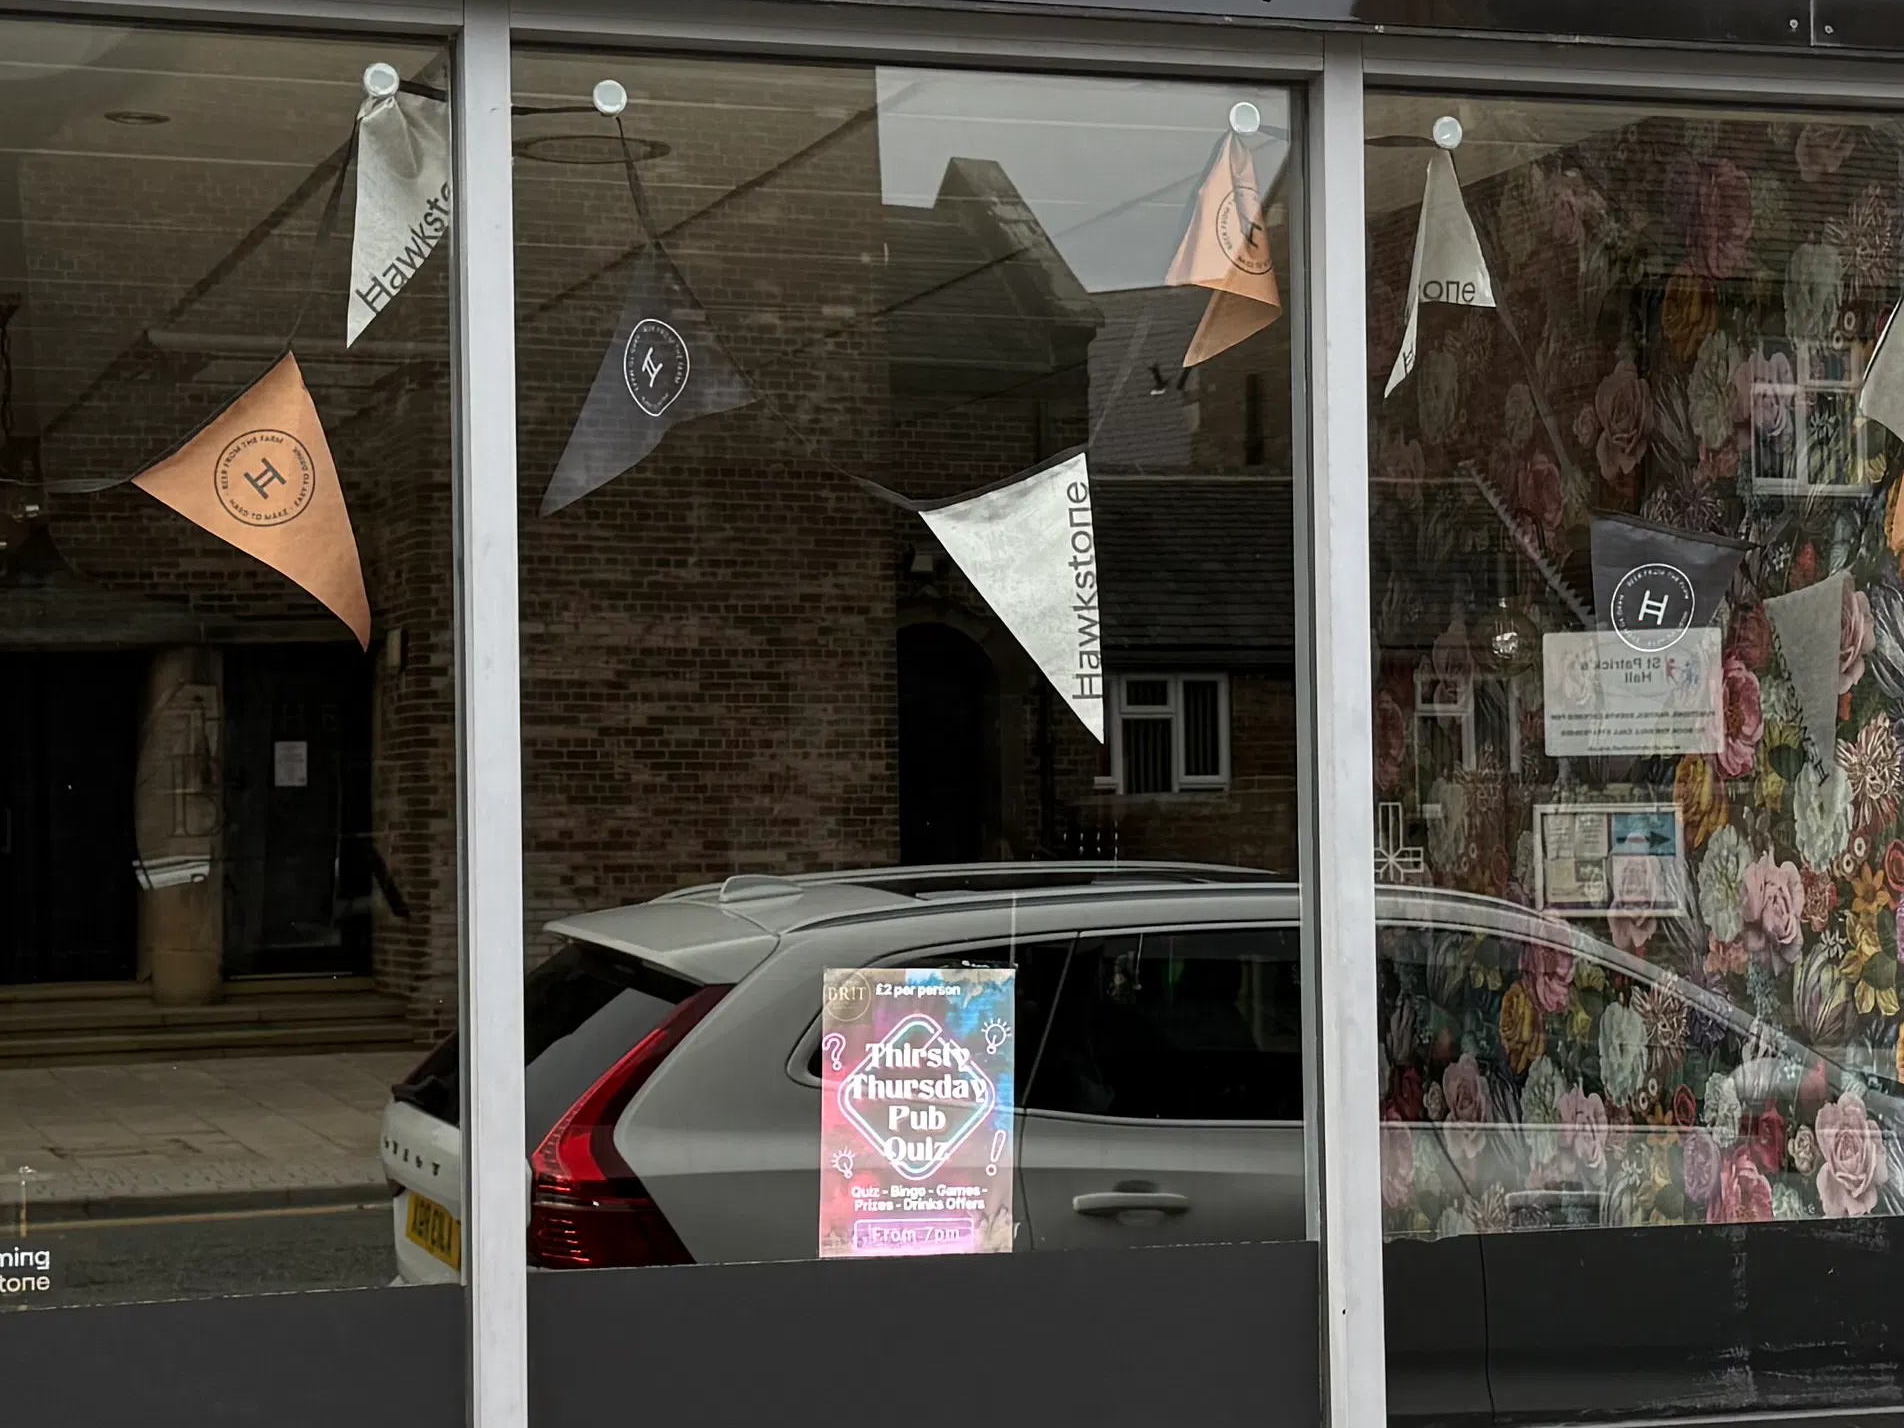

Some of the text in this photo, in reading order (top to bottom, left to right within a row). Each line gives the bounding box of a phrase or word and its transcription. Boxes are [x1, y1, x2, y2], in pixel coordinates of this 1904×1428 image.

[1066, 481, 1103, 700] Hawkstone
[876, 984, 960, 998] £2 per person
[866, 1043, 970, 1072] Thirsty
[851, 1074, 987, 1103] Thursday
[888, 1105, 947, 1131] Pub
[885, 1136, 948, 1169] Quiz
[851, 1185, 980, 1200] Quiz Bingo Games
[854, 1198, 985, 1211] Prizes Drinks Offers
[871, 1227, 960, 1246] From 7pm
